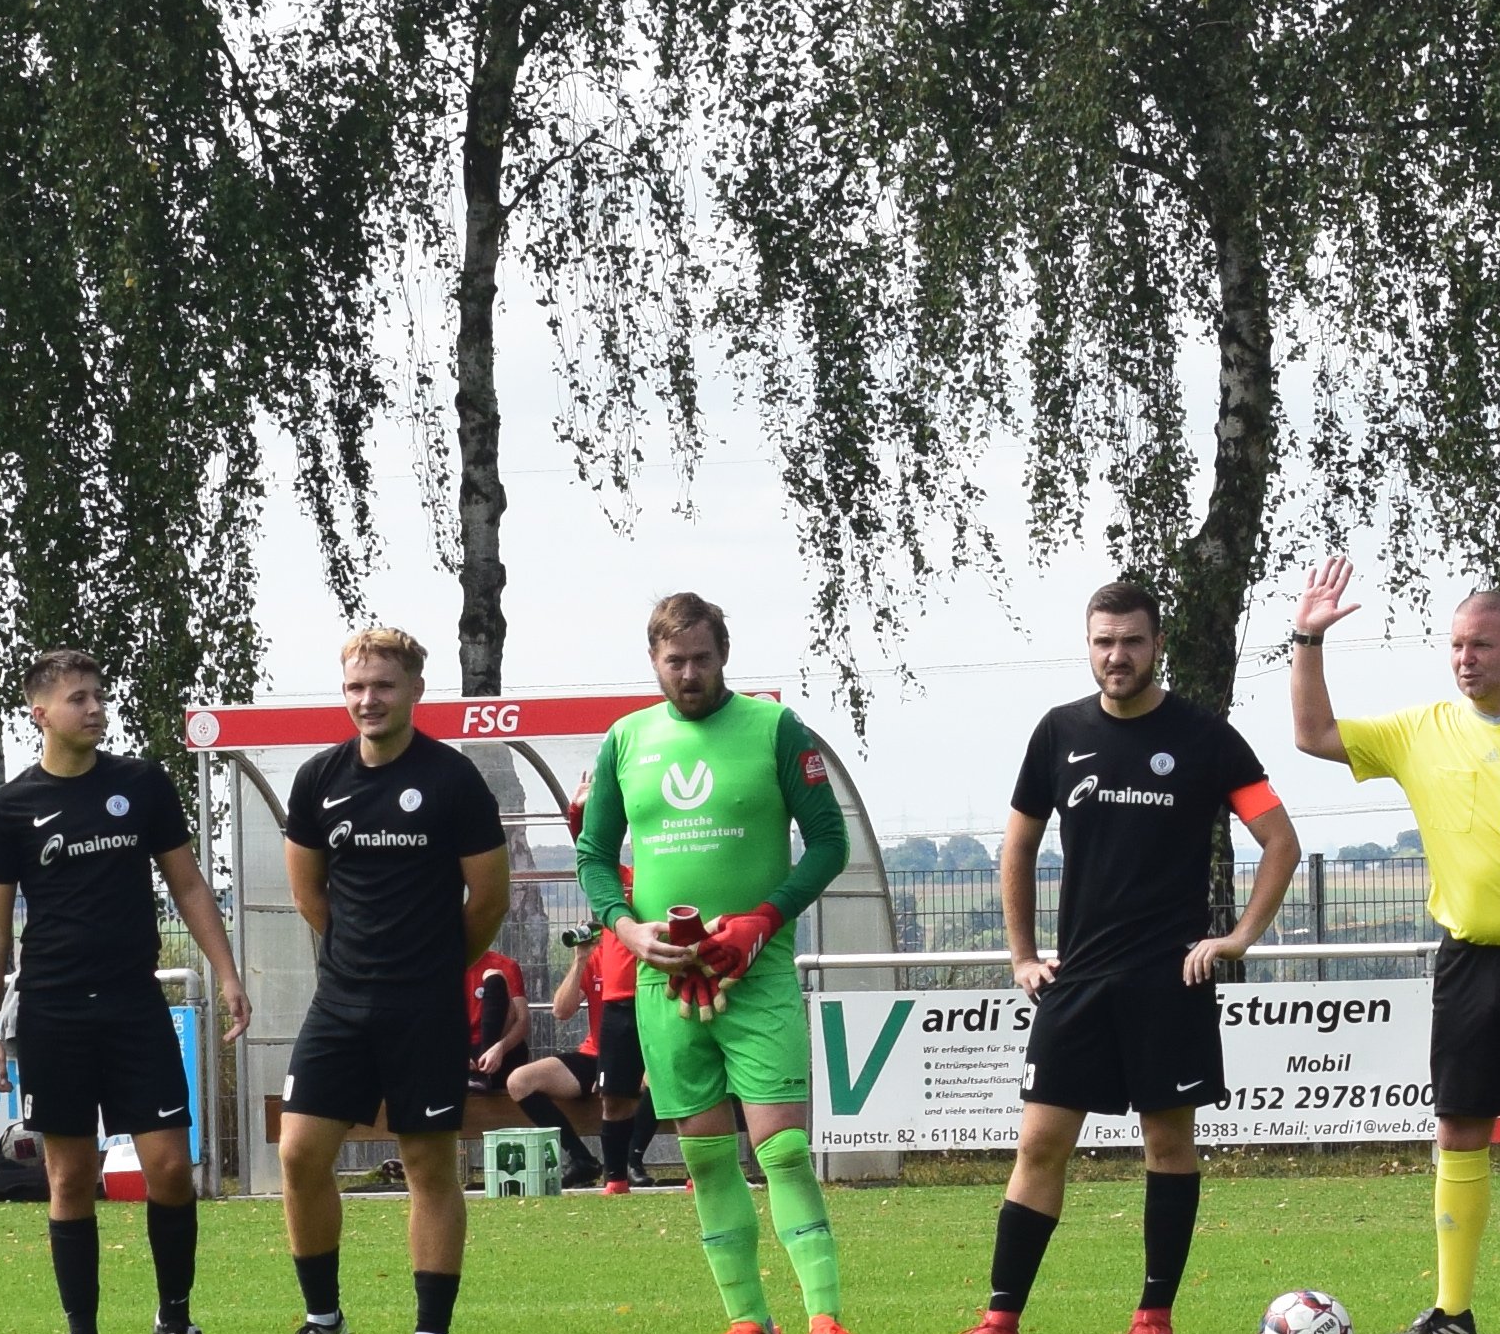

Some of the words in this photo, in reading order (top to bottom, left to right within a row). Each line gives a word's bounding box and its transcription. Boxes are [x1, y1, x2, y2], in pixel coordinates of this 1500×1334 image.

[462, 704, 520, 734] FSG
[1098, 786, 1174, 807] mainova
[662, 816, 713, 829] Deutsche
[67, 834, 139, 857] mainova
[353, 829, 428, 847] mainova
[941, 1045, 984, 1055] erledigen
[987, 1045, 1001, 1054] für
[934, 1061, 1009, 1071] Entrümpelungen
[1286, 1054, 1351, 1073] Mobil
[934, 1076, 1022, 1086] Haushaltsauflösung
[935, 1090, 994, 1101] Kleinumzüge
[1295, 1083, 1434, 1109] 29781600
[945, 1107, 967, 1115] viele
[969, 1106, 1003, 1115] weitere
[821, 1130, 892, 1147] Hauptstr.
[897, 1129, 915, 1142] 82
[931, 1128, 977, 1142] 61184
[983, 1127, 1019, 1141] Karb
[1095, 1126, 1126, 1139] Fax:
[1253, 1121, 1308, 1136] E-Mail:
[1314, 1118, 1436, 1135] vardi1@web.de
